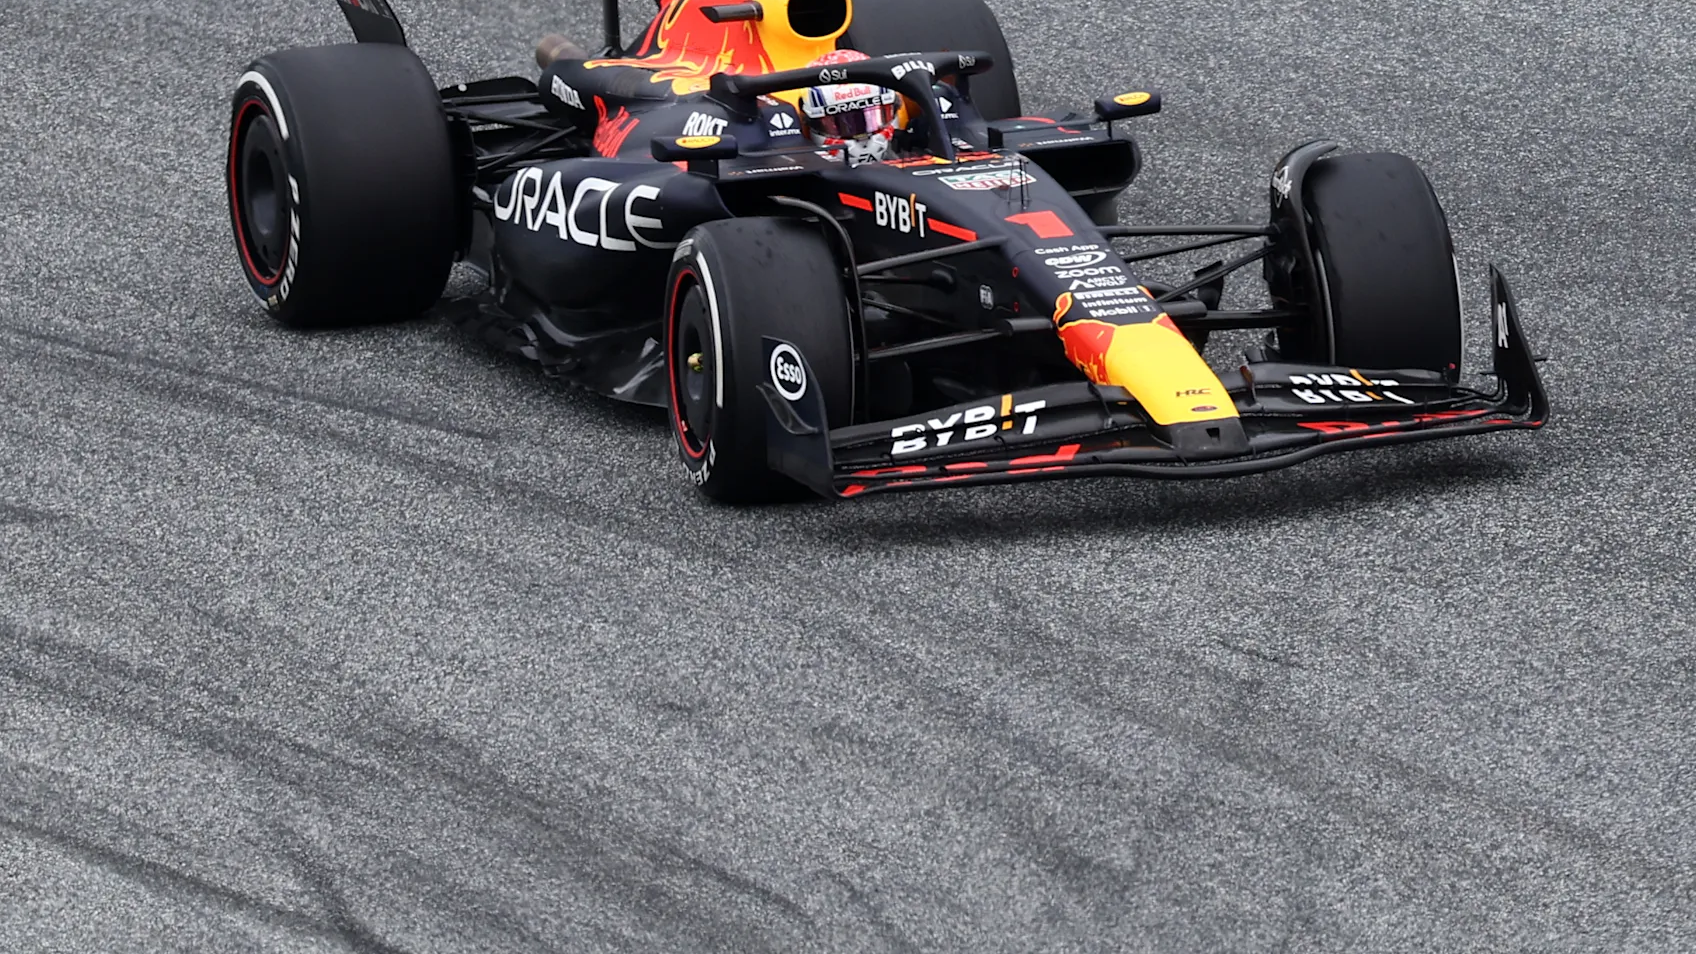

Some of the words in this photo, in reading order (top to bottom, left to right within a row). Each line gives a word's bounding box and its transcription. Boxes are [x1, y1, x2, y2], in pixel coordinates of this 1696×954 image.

[891, 60, 936, 80] BILLA
[834, 90, 853, 101] Red
[854, 86, 871, 97] Bull
[825, 96, 881, 115] ORACLE
[682, 111, 729, 136] ROKT
[494, 167, 684, 252] ORACLE
[874, 191, 927, 238] BYBIT
[1004, 210, 1074, 239] 1
[279, 207, 300, 300] ZERO
[1034, 246, 1070, 255] Cash
[1071, 244, 1099, 252] App
[1045, 252, 1095, 267] CDW
[1089, 306, 1138, 318] Mobil
[1175, 388, 1212, 397] HRC
